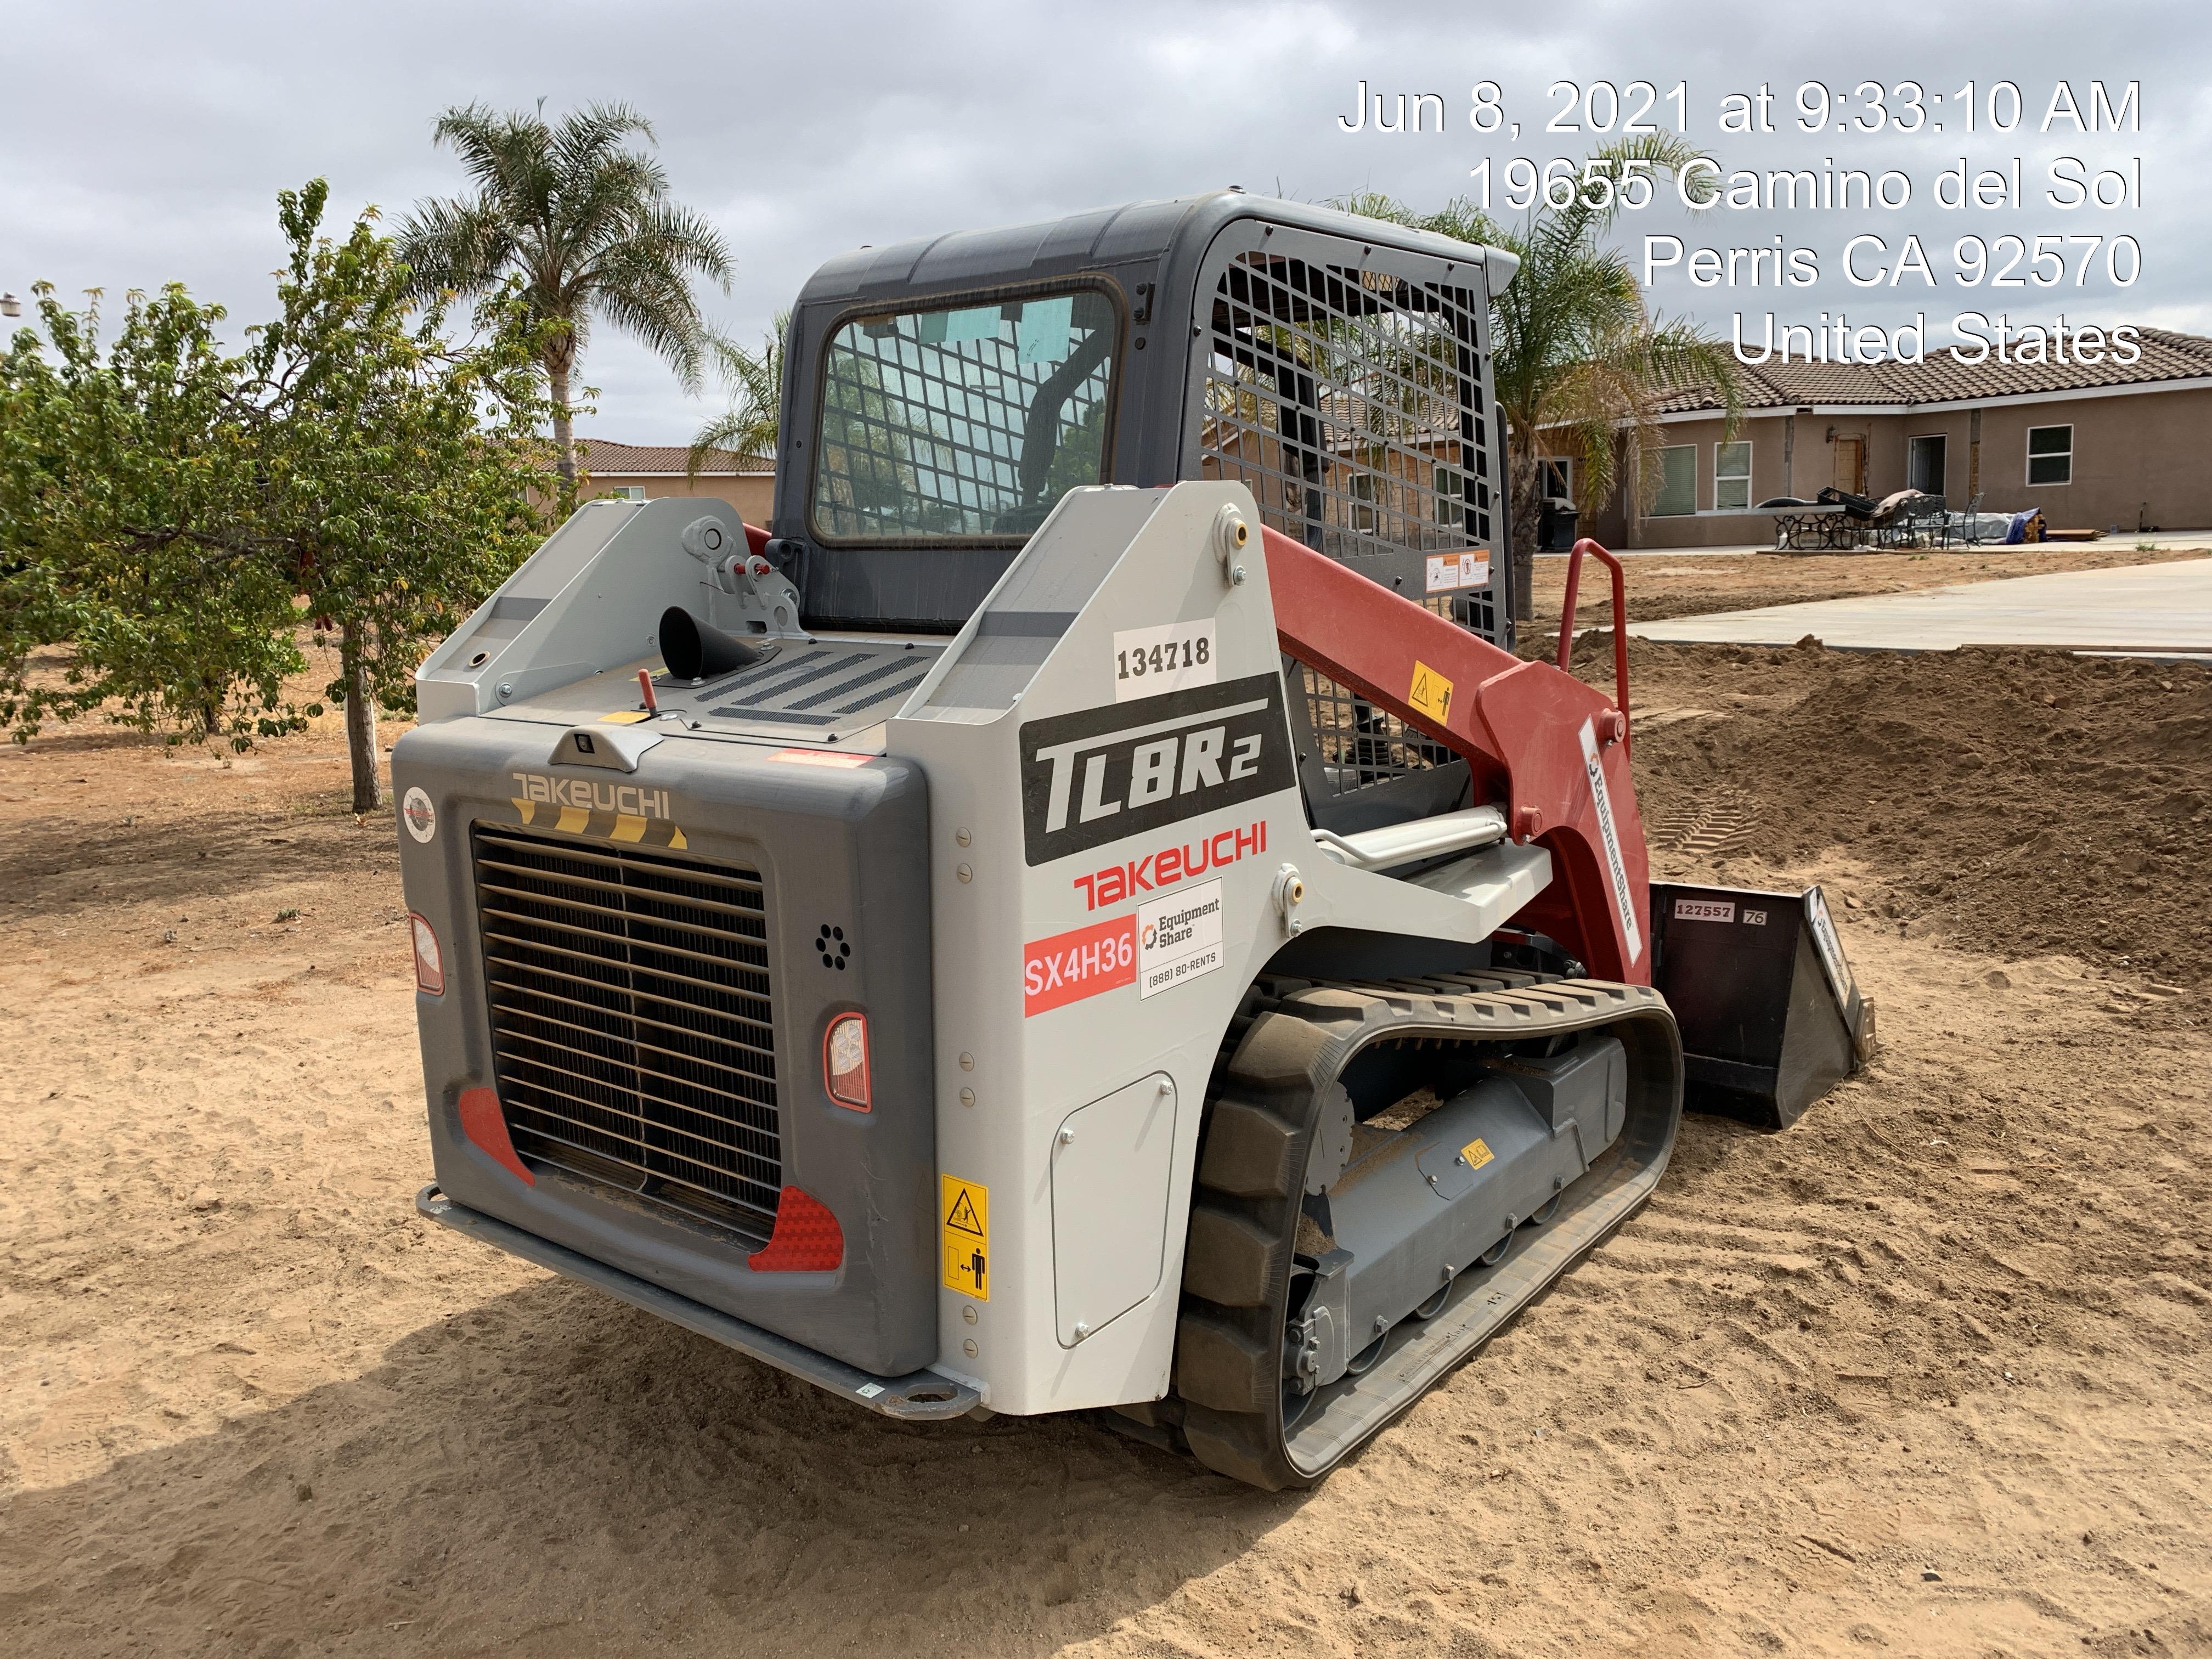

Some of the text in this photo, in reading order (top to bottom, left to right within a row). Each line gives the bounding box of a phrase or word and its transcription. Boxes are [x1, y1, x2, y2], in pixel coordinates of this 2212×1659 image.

[1118, 636, 1210, 680] 134718
[1035, 697, 1269, 833] TL8R2
[1594, 773, 1632, 931] EquipmentShare
[1159, 898, 1220, 932] Equipment
[1677, 904, 1764, 924] 127557 76
[1159, 927, 1193, 949] Share
[1025, 932, 1133, 996] SX4H36
[1149, 952, 1216, 988] (888) 80-RENTS
